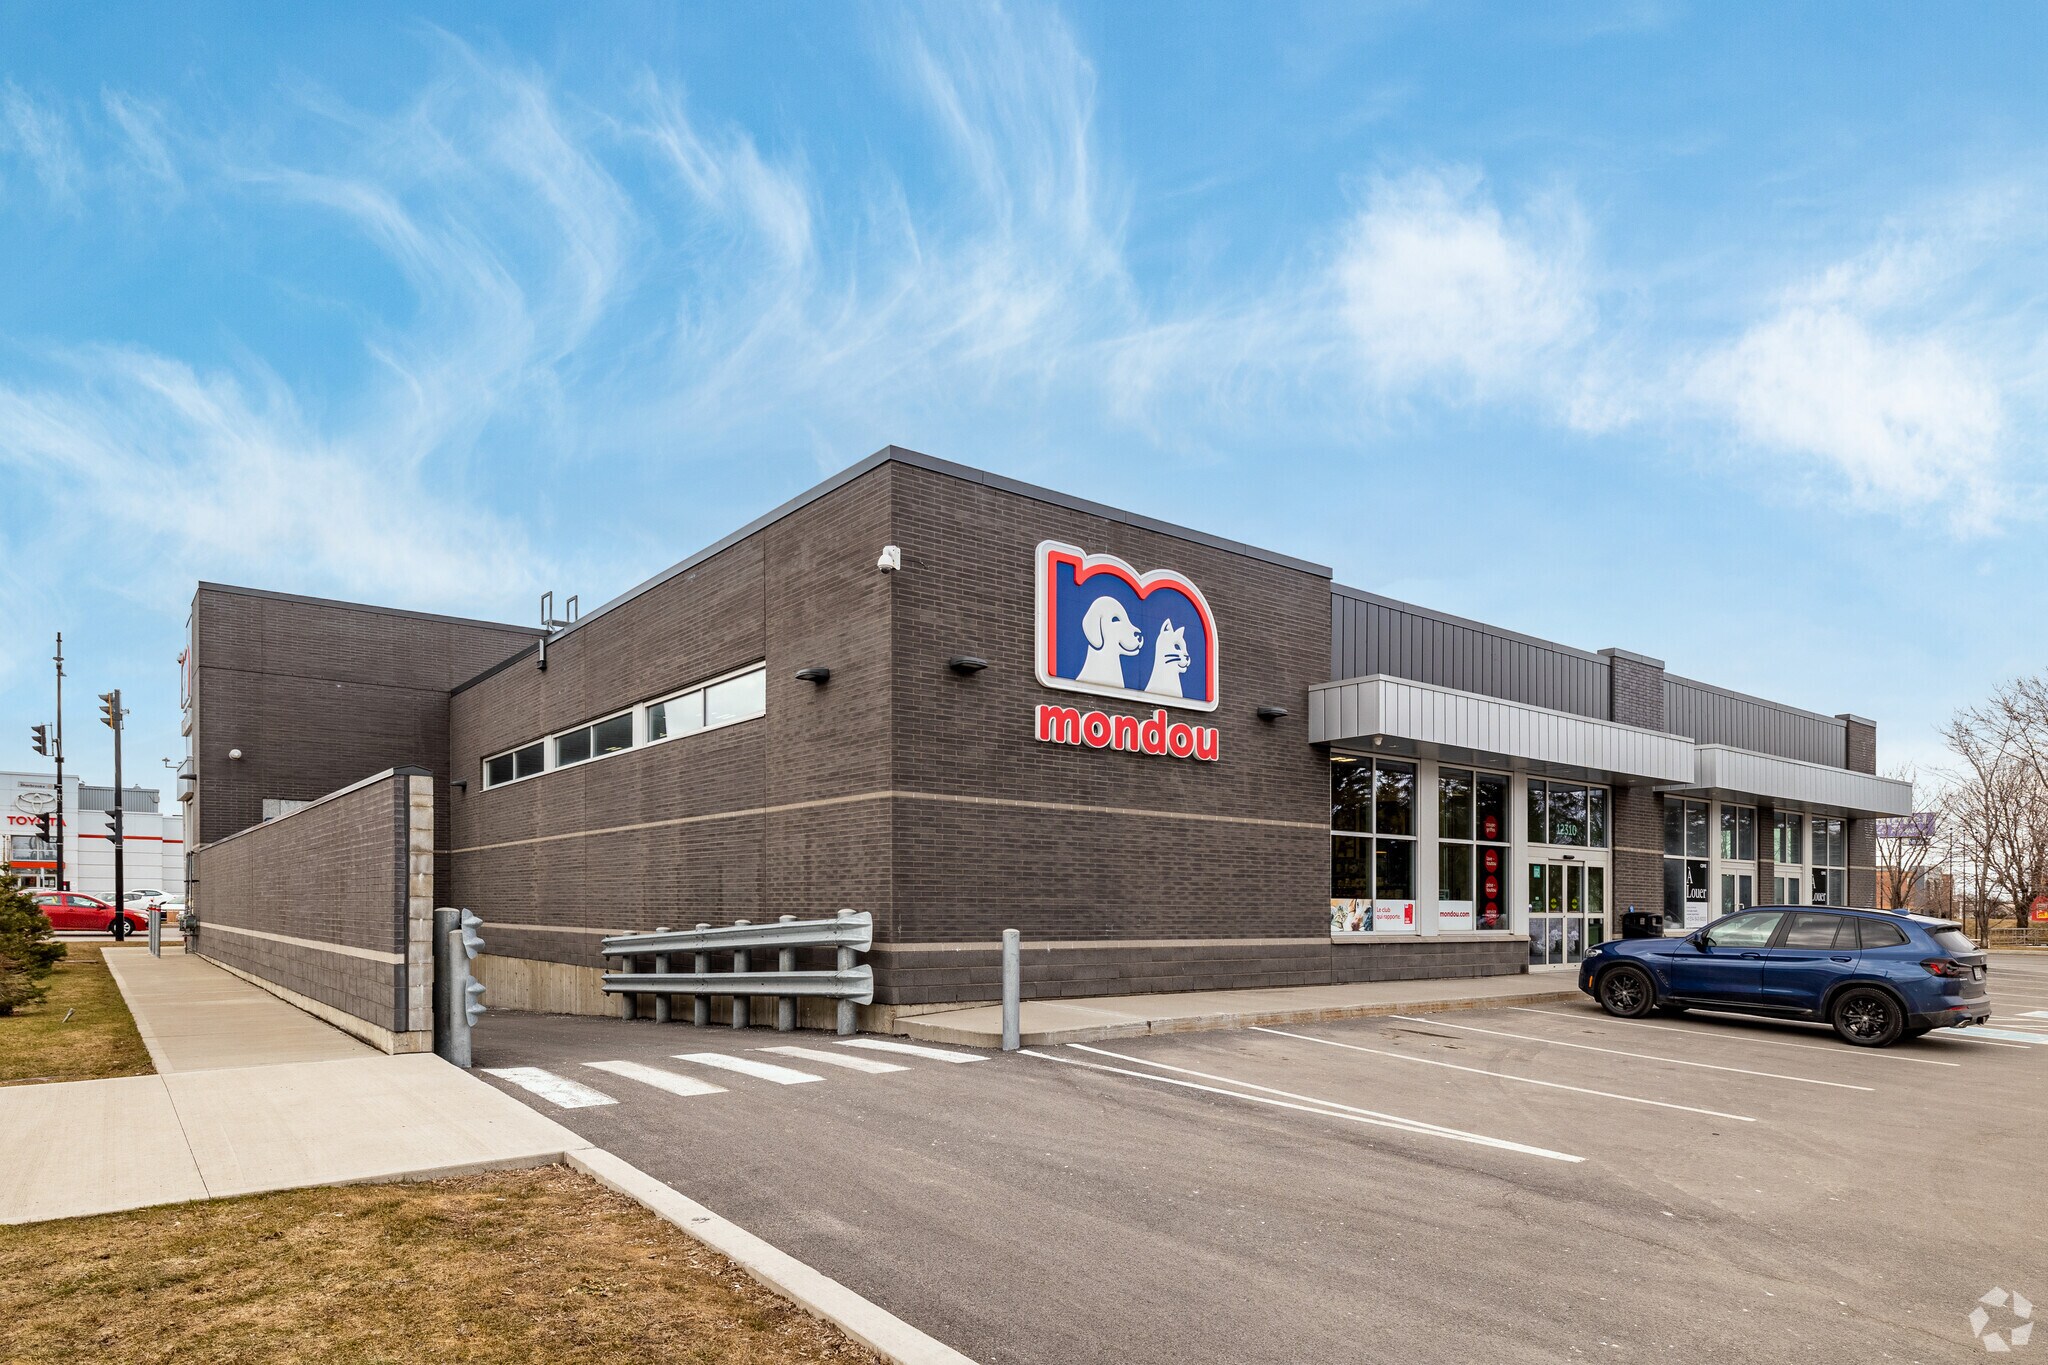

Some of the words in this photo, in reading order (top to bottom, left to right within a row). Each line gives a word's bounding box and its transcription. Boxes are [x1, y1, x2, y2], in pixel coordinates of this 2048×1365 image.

[1036, 704, 1219, 761] mondou
[7, 816, 67, 827] TOYT
[1556, 823, 1577, 836] 12310
[1686, 884, 1707, 899] Louer
